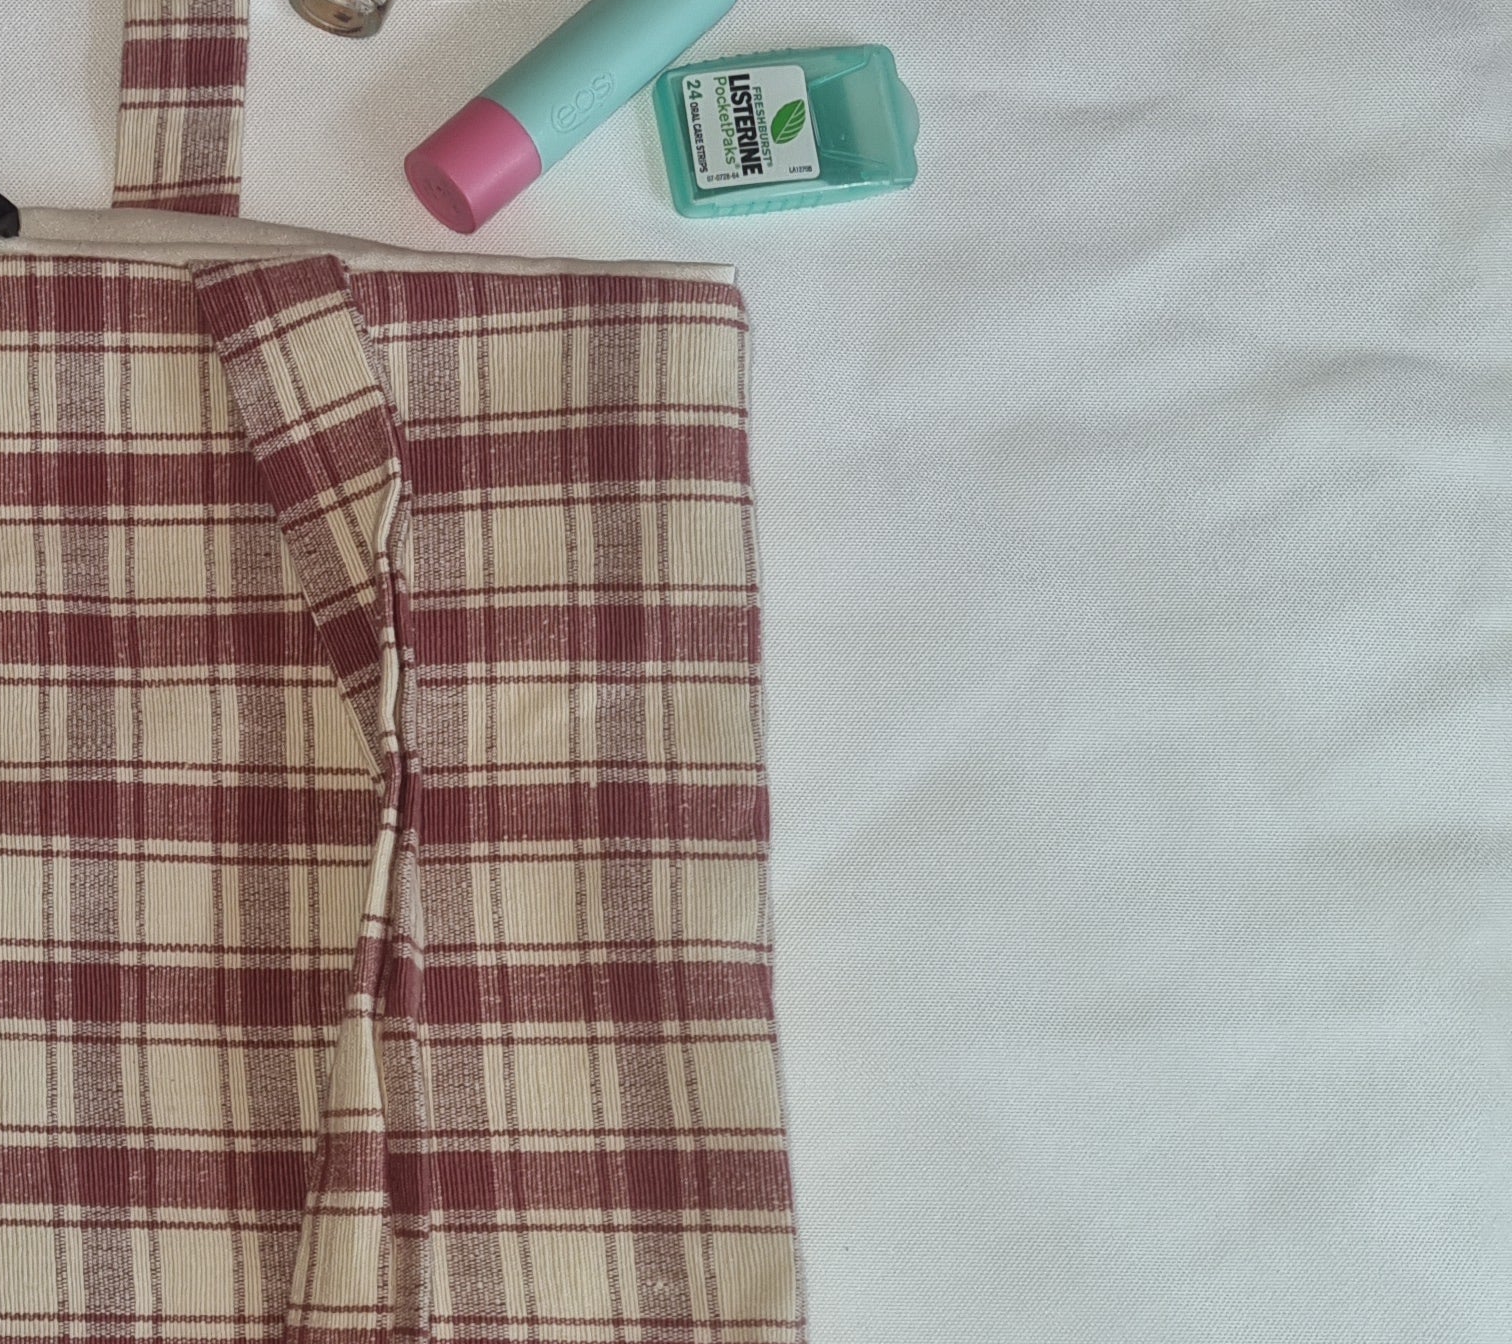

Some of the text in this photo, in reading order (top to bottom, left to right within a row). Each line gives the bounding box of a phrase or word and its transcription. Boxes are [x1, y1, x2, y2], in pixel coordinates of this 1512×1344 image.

[687, 79, 708, 173] 24 ORAL CARE STRIPS
[728, 73, 763, 176] LISTERINE
